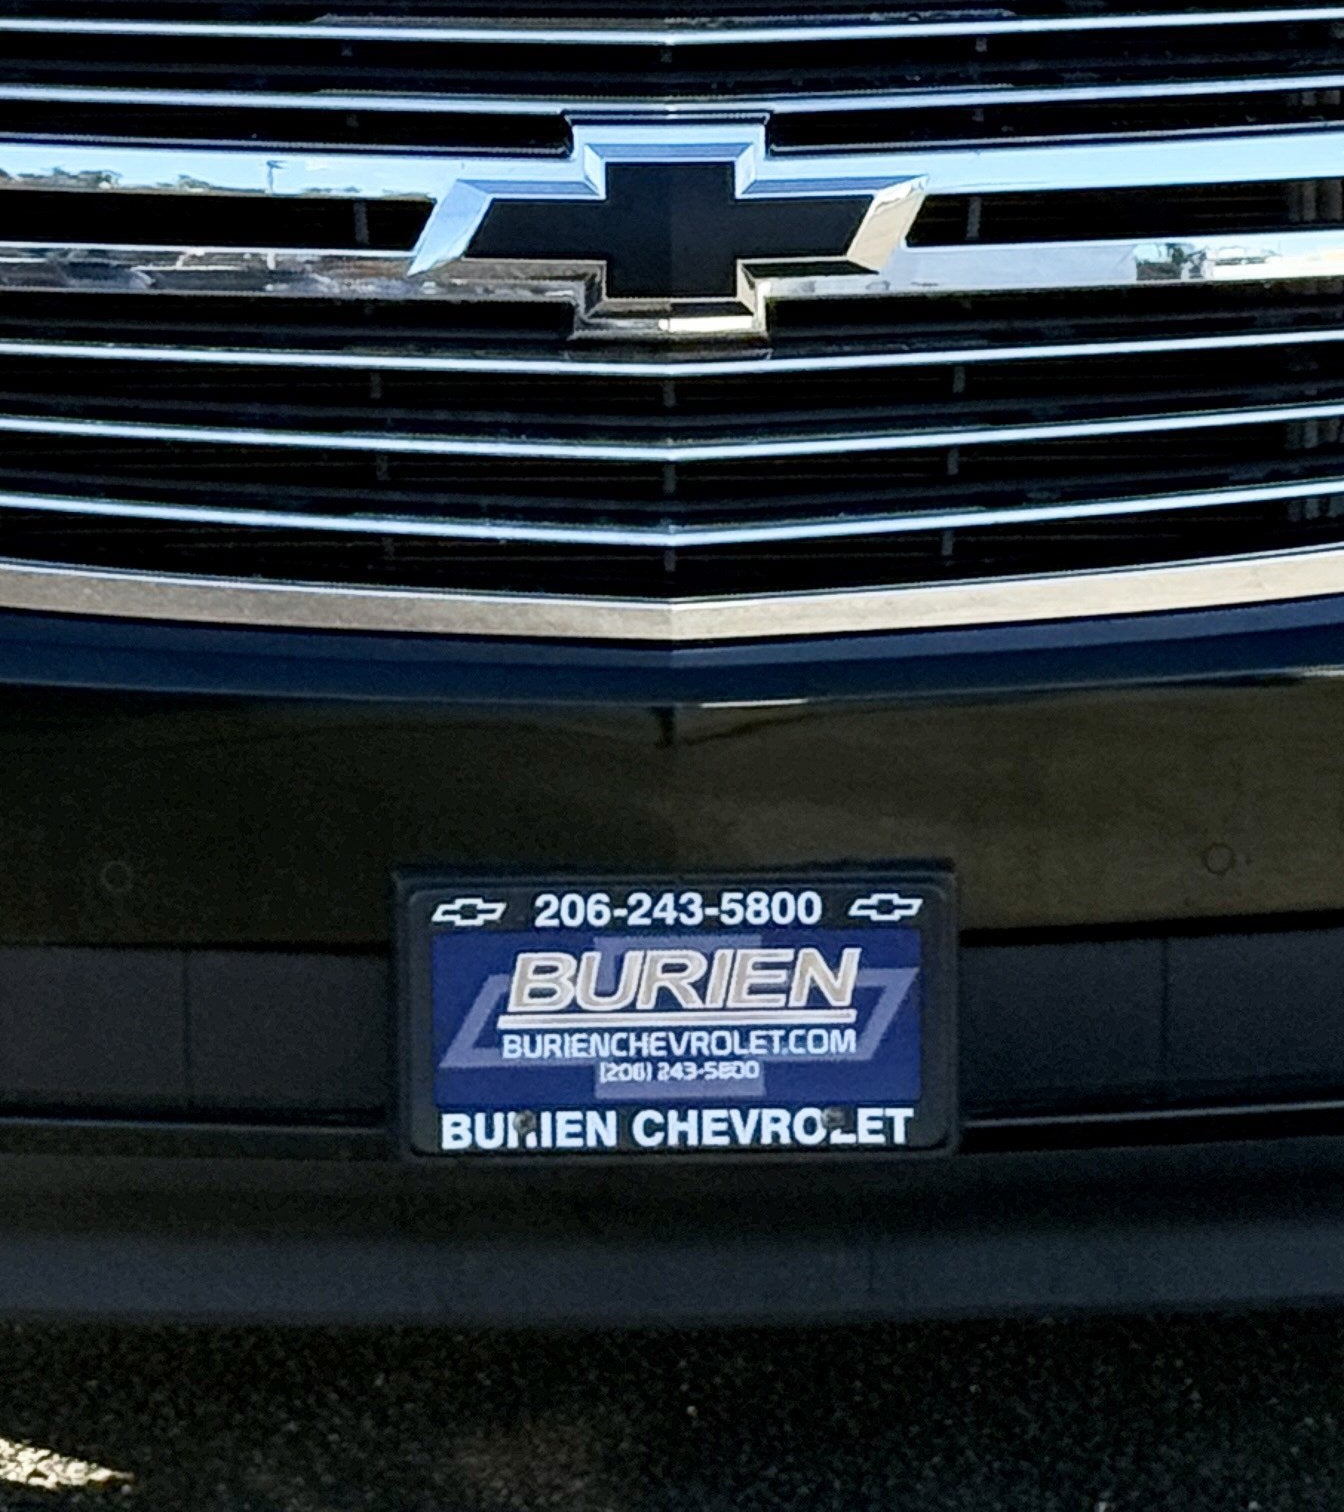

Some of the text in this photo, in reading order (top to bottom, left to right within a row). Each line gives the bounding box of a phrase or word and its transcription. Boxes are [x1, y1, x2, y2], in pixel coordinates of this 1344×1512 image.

[533, 891, 823, 928] 206-243-5800
[506, 946, 862, 1013] BURIEN
[501, 1028, 858, 1059] BURIENCHEVROLET.COM
[599, 1060, 761, 1084] (206) 243-5800
